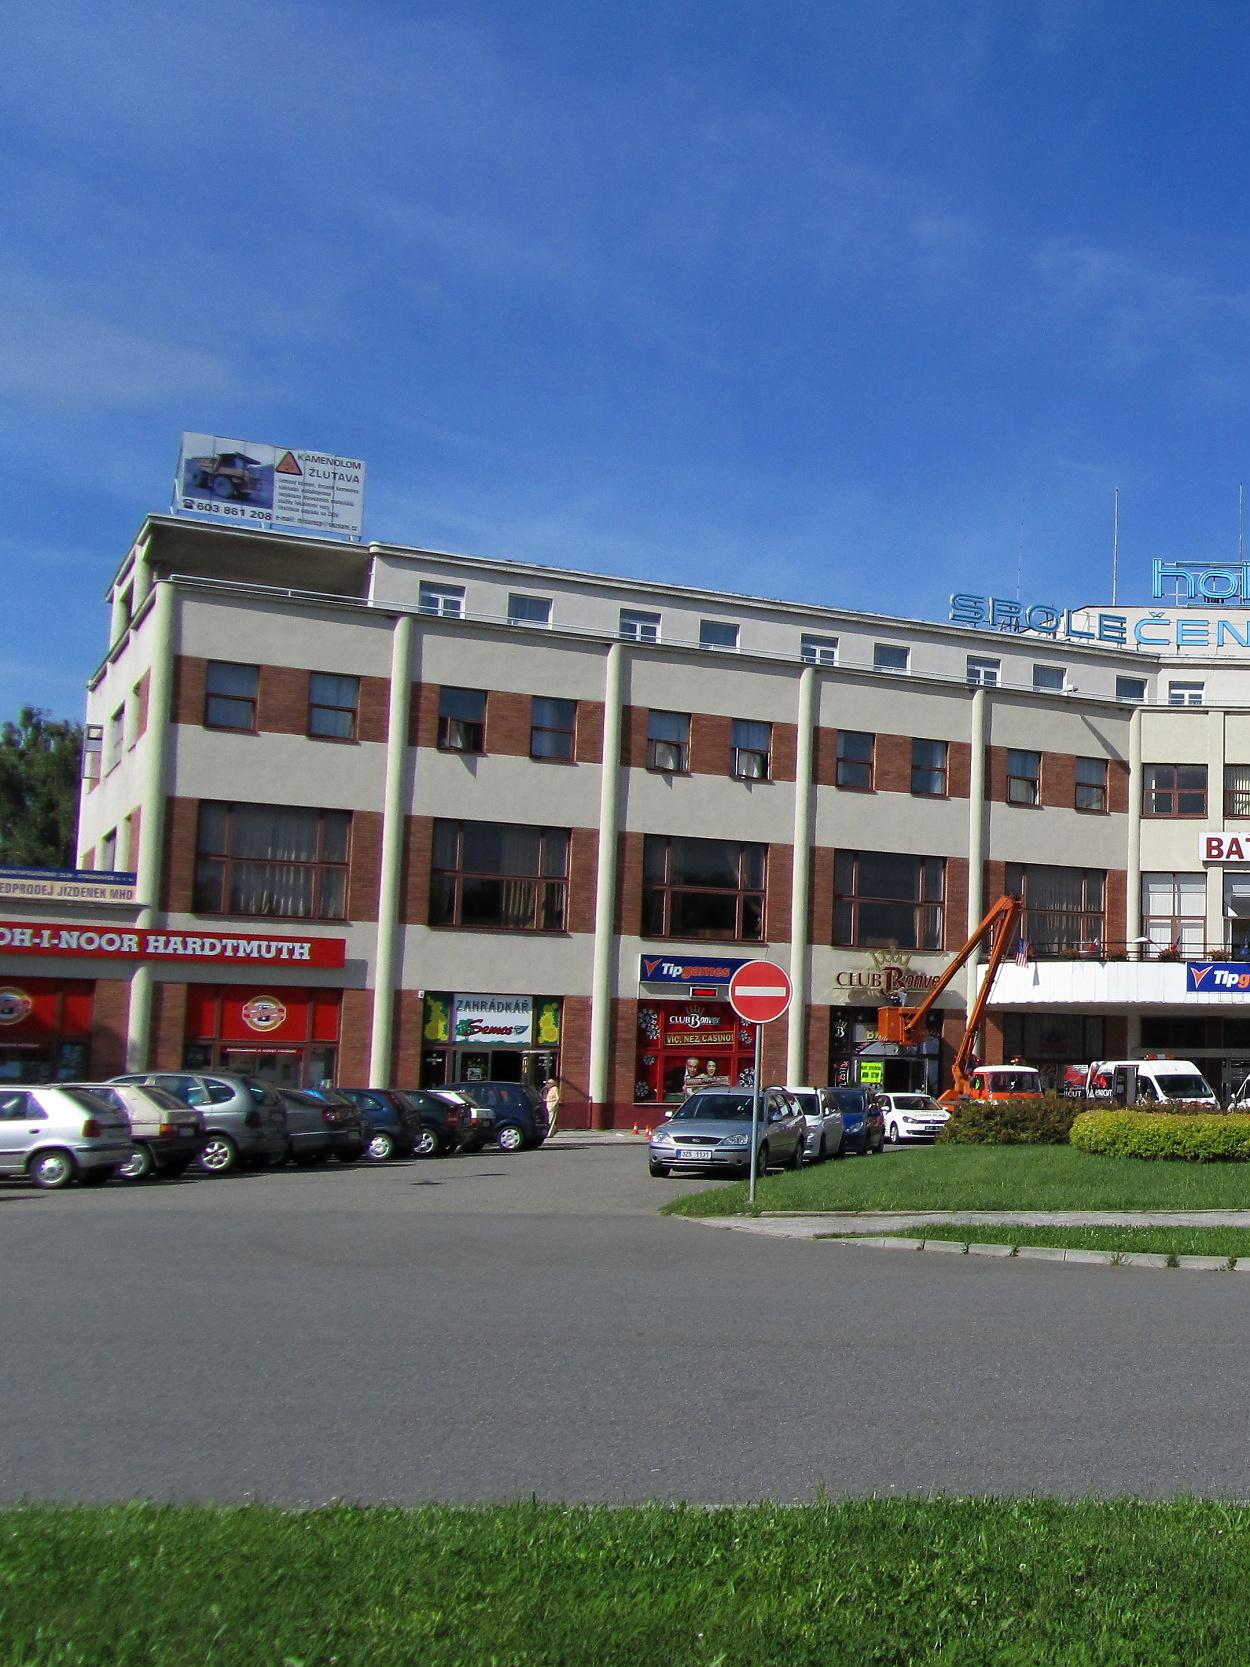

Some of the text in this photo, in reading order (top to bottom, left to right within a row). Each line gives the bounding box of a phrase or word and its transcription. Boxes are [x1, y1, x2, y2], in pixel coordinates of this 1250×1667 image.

[197, 502, 219, 513] 603
[223, 506, 245, 517] 861
[250, 510, 272, 521] 208
[110, 888, 133, 900] MHD
[146, 935, 311, 960] HARDTMUTH
[662, 962, 731, 979] Tipgames
[836, 966, 943, 998] CLUB Bonve
[669, 1015, 690, 1024] CLUB
